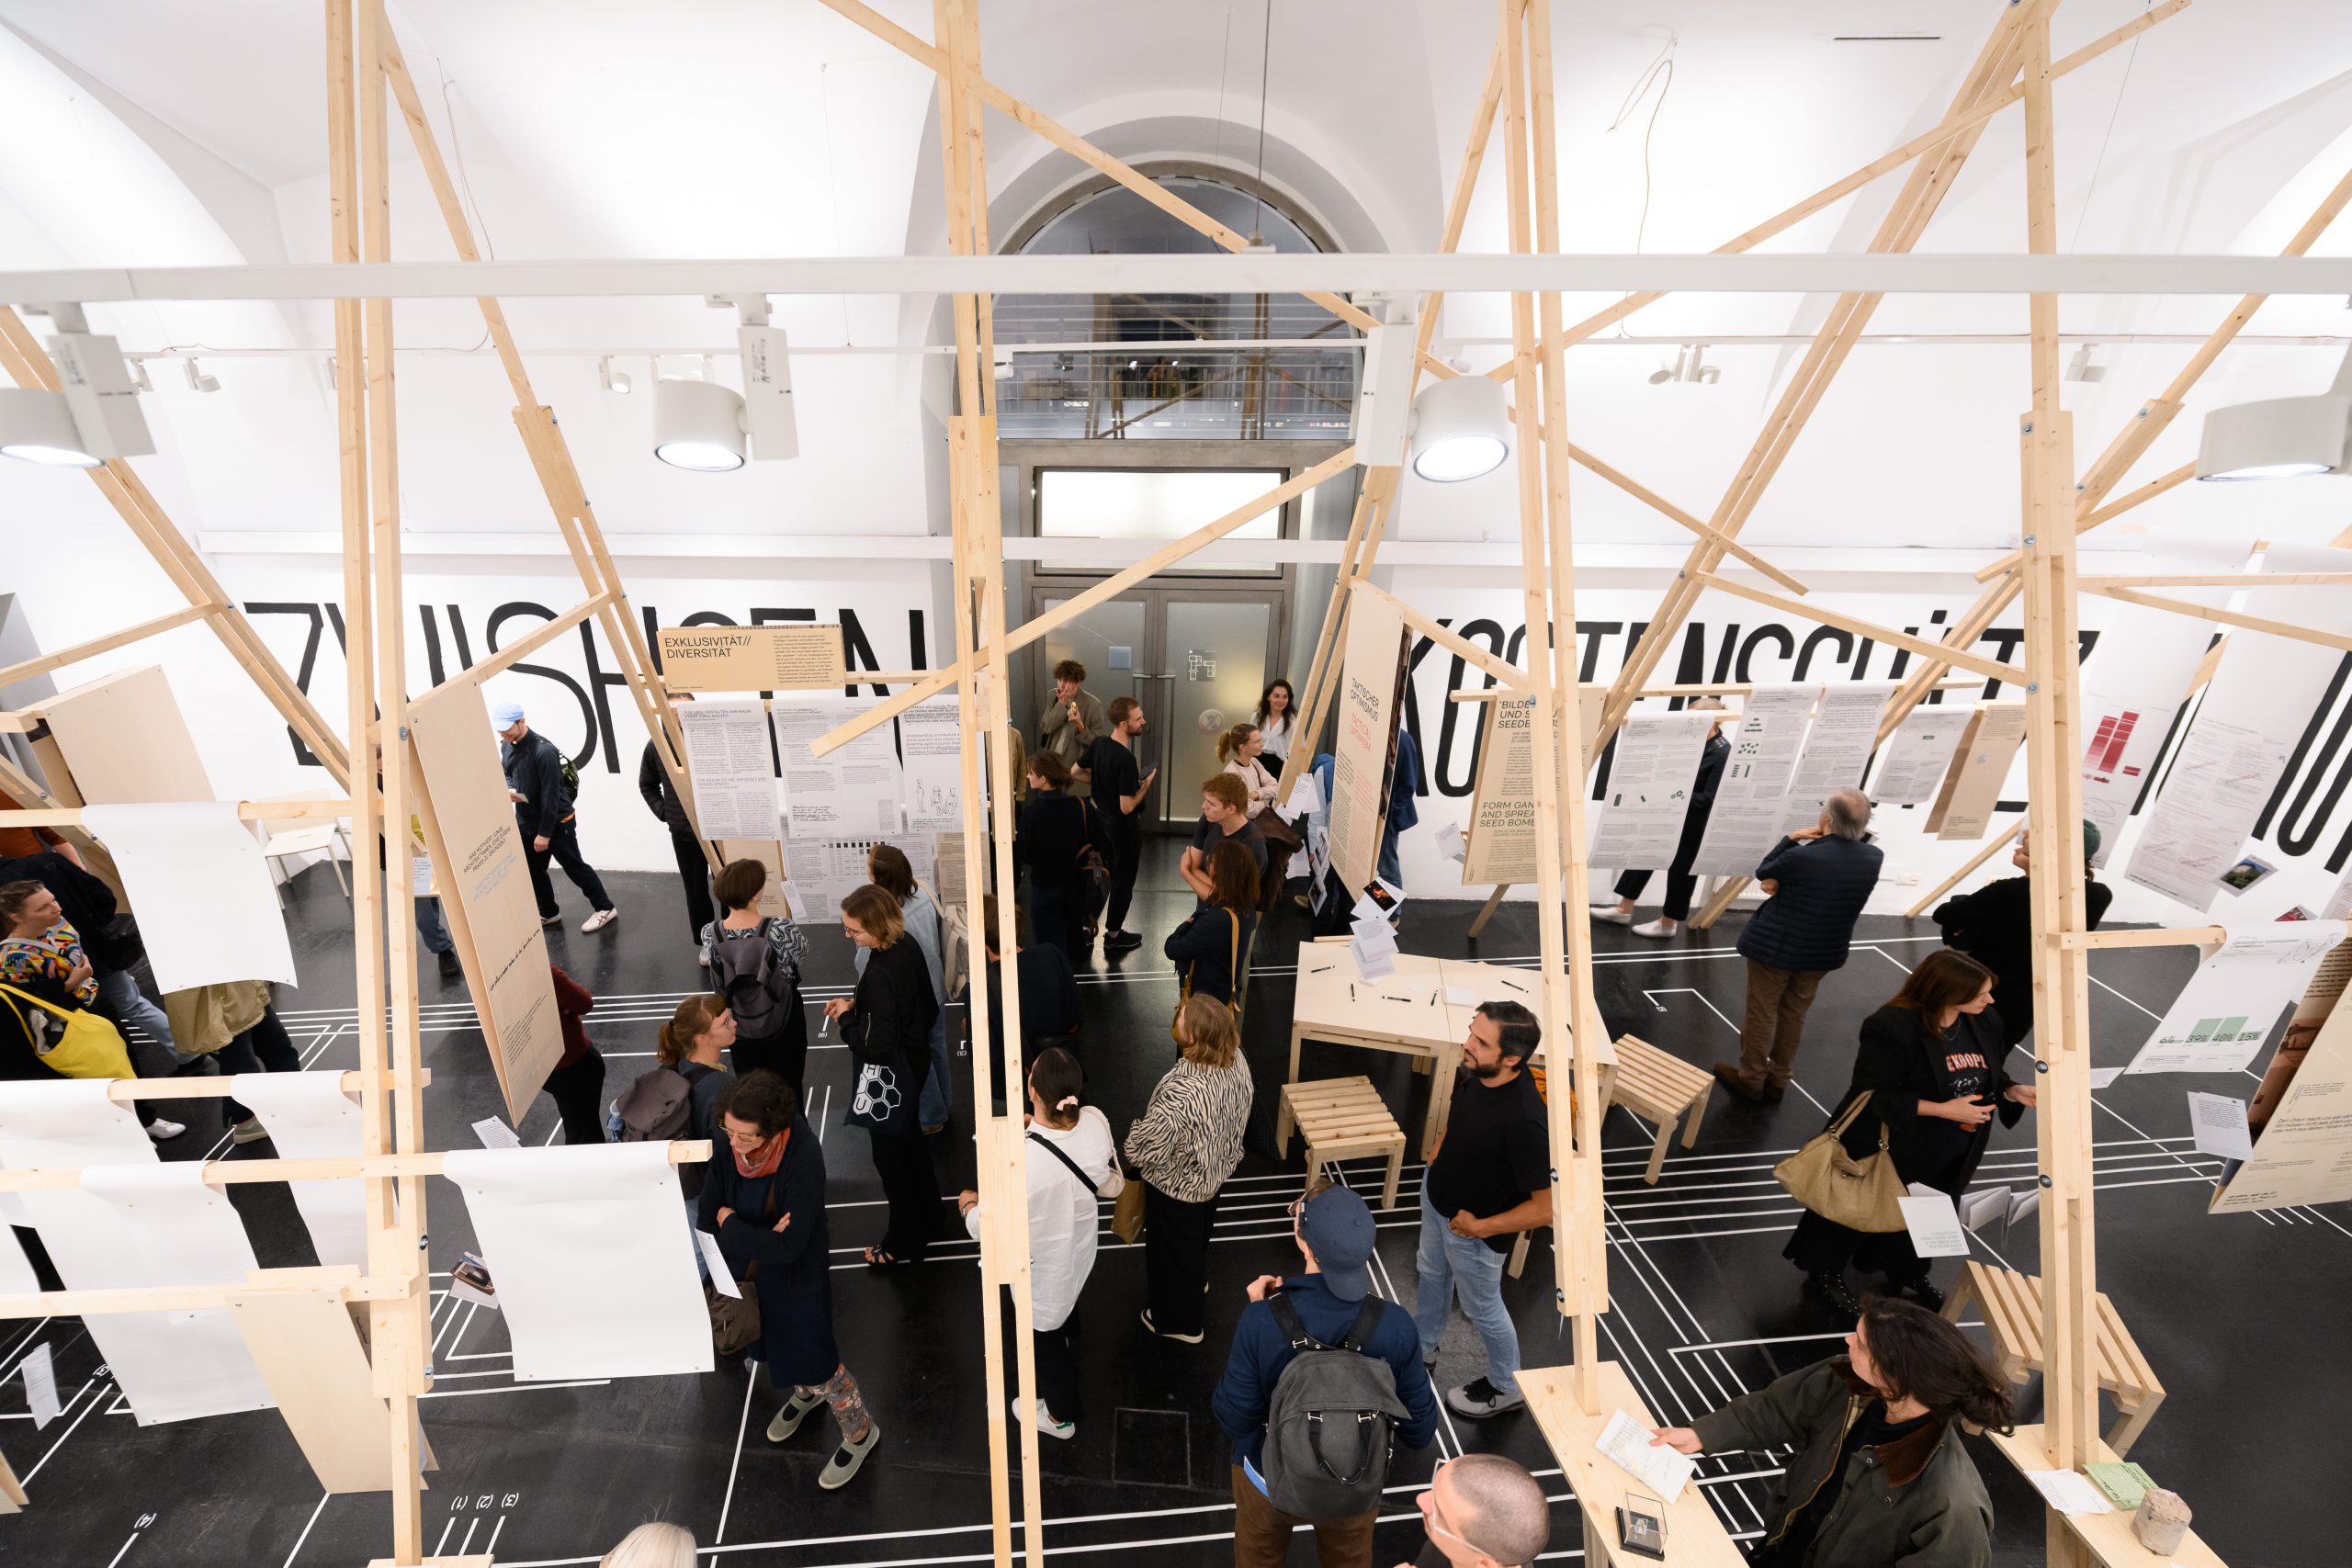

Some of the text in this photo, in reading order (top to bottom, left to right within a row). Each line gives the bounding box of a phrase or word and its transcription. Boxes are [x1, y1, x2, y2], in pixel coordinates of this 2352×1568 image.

[664, 635, 752, 648] EXKLUSIVITÄT//
[667, 647, 731, 659] DIVERSITÄT
[1352, 677, 1379, 710] TAKTISCHER
[1351, 689, 1378, 722] OPTIMISMUS
[1499, 710, 1521, 718] UND
[1483, 801, 1511, 809] FORM
[2186, 1034, 2208, 1043] 39%
[2237, 1032, 2258, 1041] 15%
[451, 1495, 468, 1510] (1)
[476, 1494, 493, 1509] (2)
[502, 1493, 519, 1508] (3)
[134, 1513, 157, 1529] (4)
